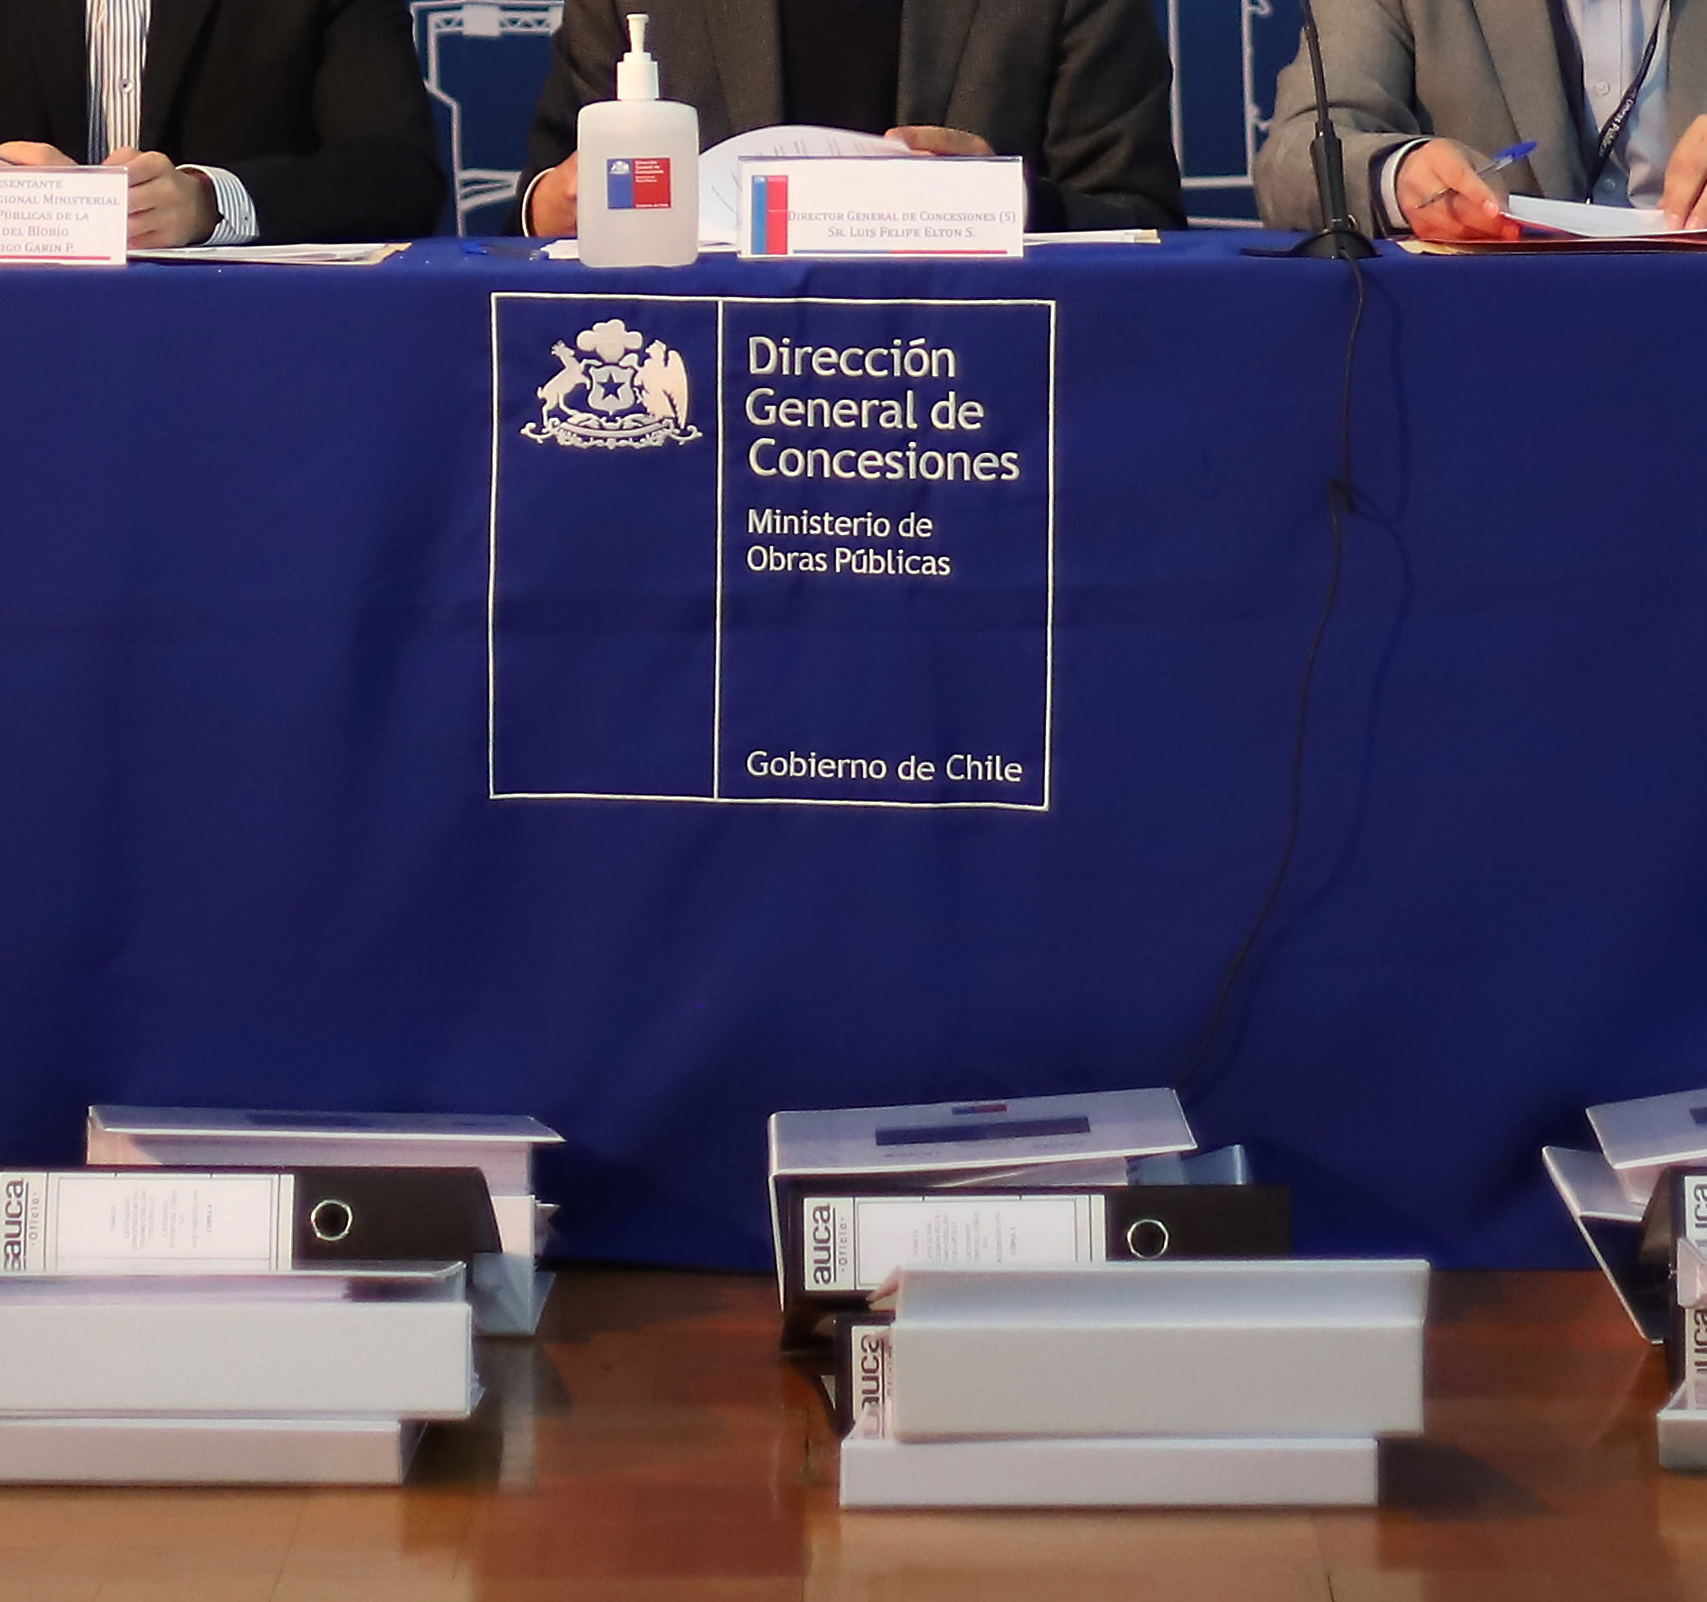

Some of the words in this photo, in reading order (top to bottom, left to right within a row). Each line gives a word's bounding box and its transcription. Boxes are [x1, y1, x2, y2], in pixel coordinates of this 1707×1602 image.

[747, 335, 957, 379] Dirección
[744, 386, 919, 431] General
[929, 389, 986, 432] de
[747, 436, 1021, 483] Concesiones
[747, 507, 892, 539] Ministerio
[897, 510, 934, 539] de
[745, 544, 829, 573] Obras
[834, 546, 952, 577] Públicas
[745, 749, 888, 781] Gobierno
[896, 754, 937, 782] de
[945, 752, 1024, 784] Chile
[811, 1202, 833, 1285] auca
